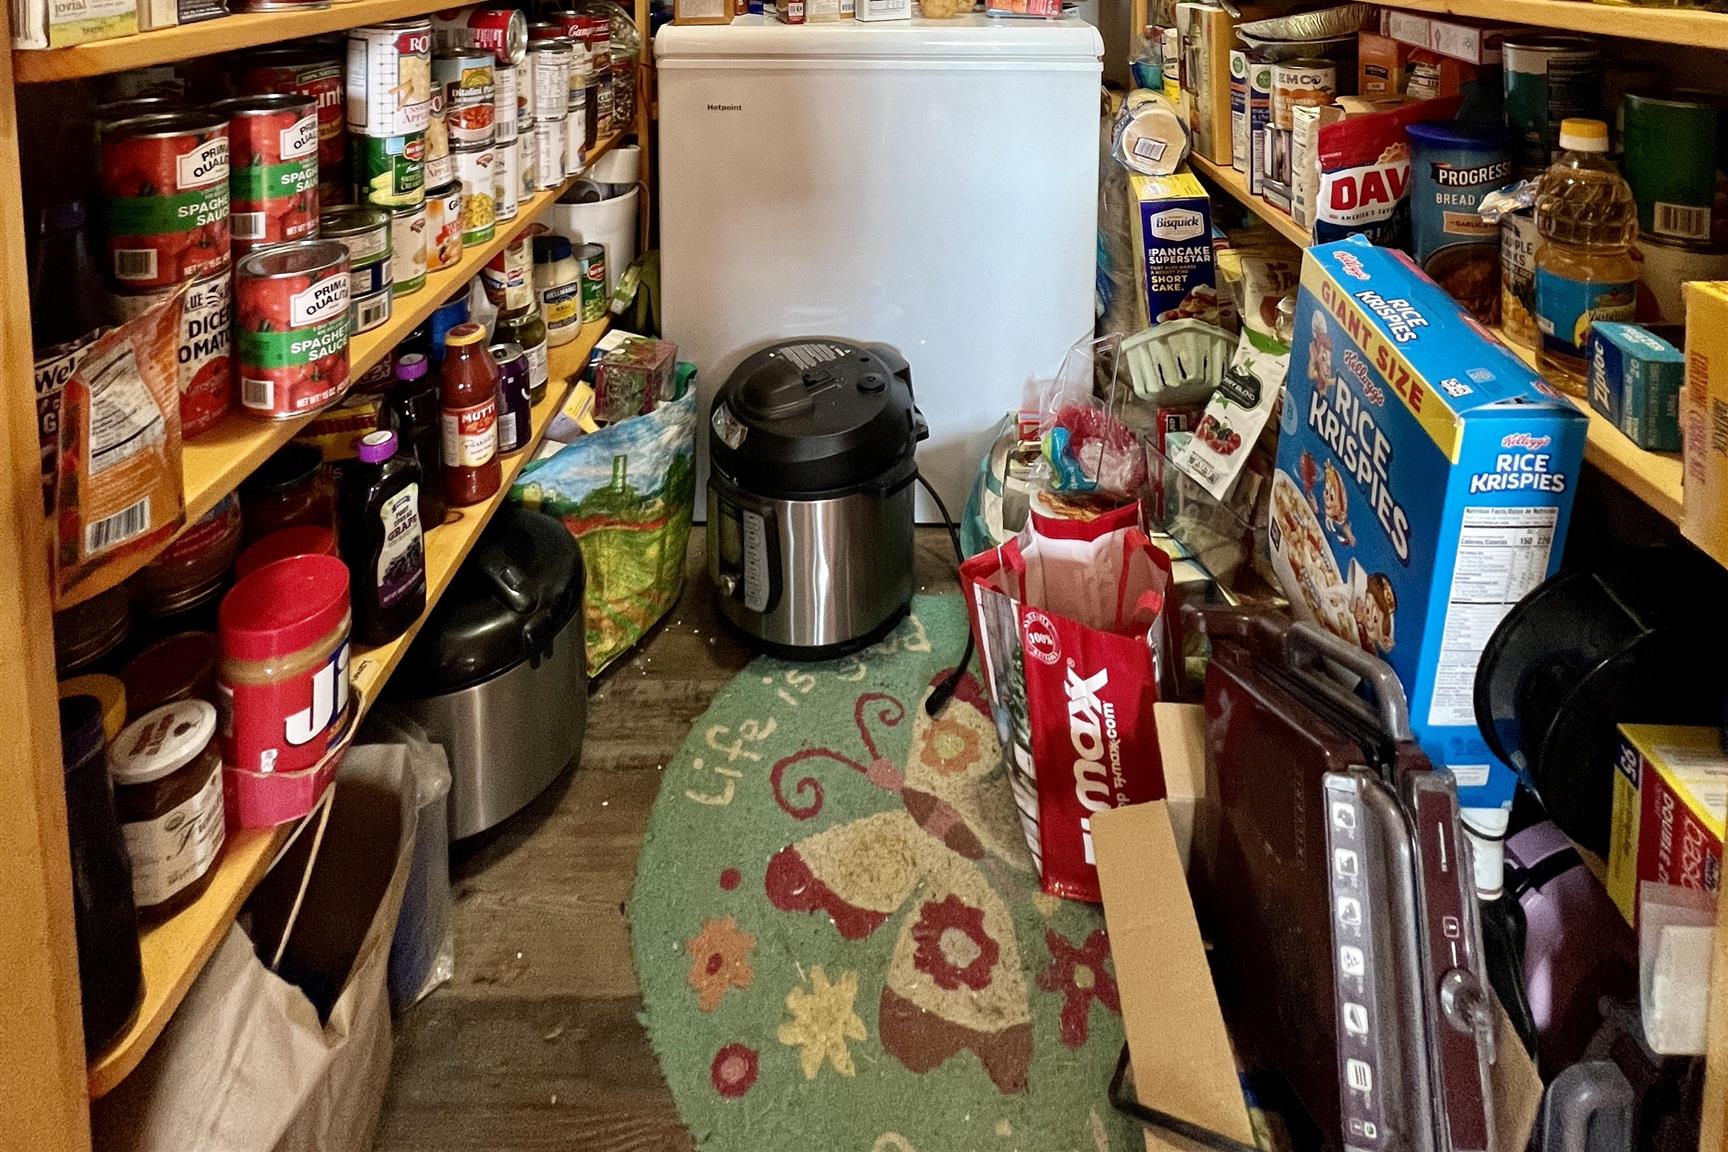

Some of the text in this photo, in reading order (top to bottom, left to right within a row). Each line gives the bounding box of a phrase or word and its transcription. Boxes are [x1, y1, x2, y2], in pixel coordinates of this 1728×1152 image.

[1438, 160, 1512, 186] PROGRESS
[1330, 166, 1409, 211] DAV
[1435, 192, 1476, 207] BREAD
[1156, 216, 1200, 230] Bisquick
[1148, 254, 1211, 265] SUPERSTAR
[313, 278, 348, 300] PRIMA
[1151, 275, 1188, 284] SHORT
[1151, 284, 1185, 292] CAKE.
[188, 305, 231, 339] DICE
[1354, 289, 1418, 344] KRISPIES
[1387, 297, 1430, 328] RICE
[308, 336, 349, 361] SAUCE
[1320, 280, 1373, 351] GIANT
[1375, 344, 1425, 414] SIZE
[35, 357, 76, 394] Wel
[1592, 338, 1611, 411] Ziploc
[461, 403, 496, 424] MUTTI
[1333, 375, 1394, 469] RICE
[1308, 390, 1411, 562] KRISPIES
[1496, 453, 1550, 473] RICE
[1469, 472, 1566, 494] KRISPIES
[1028, 630, 1054, 647] 100%
[685, 668, 816, 806] Life is
[1659, 790, 1677, 867] DOUBLE
